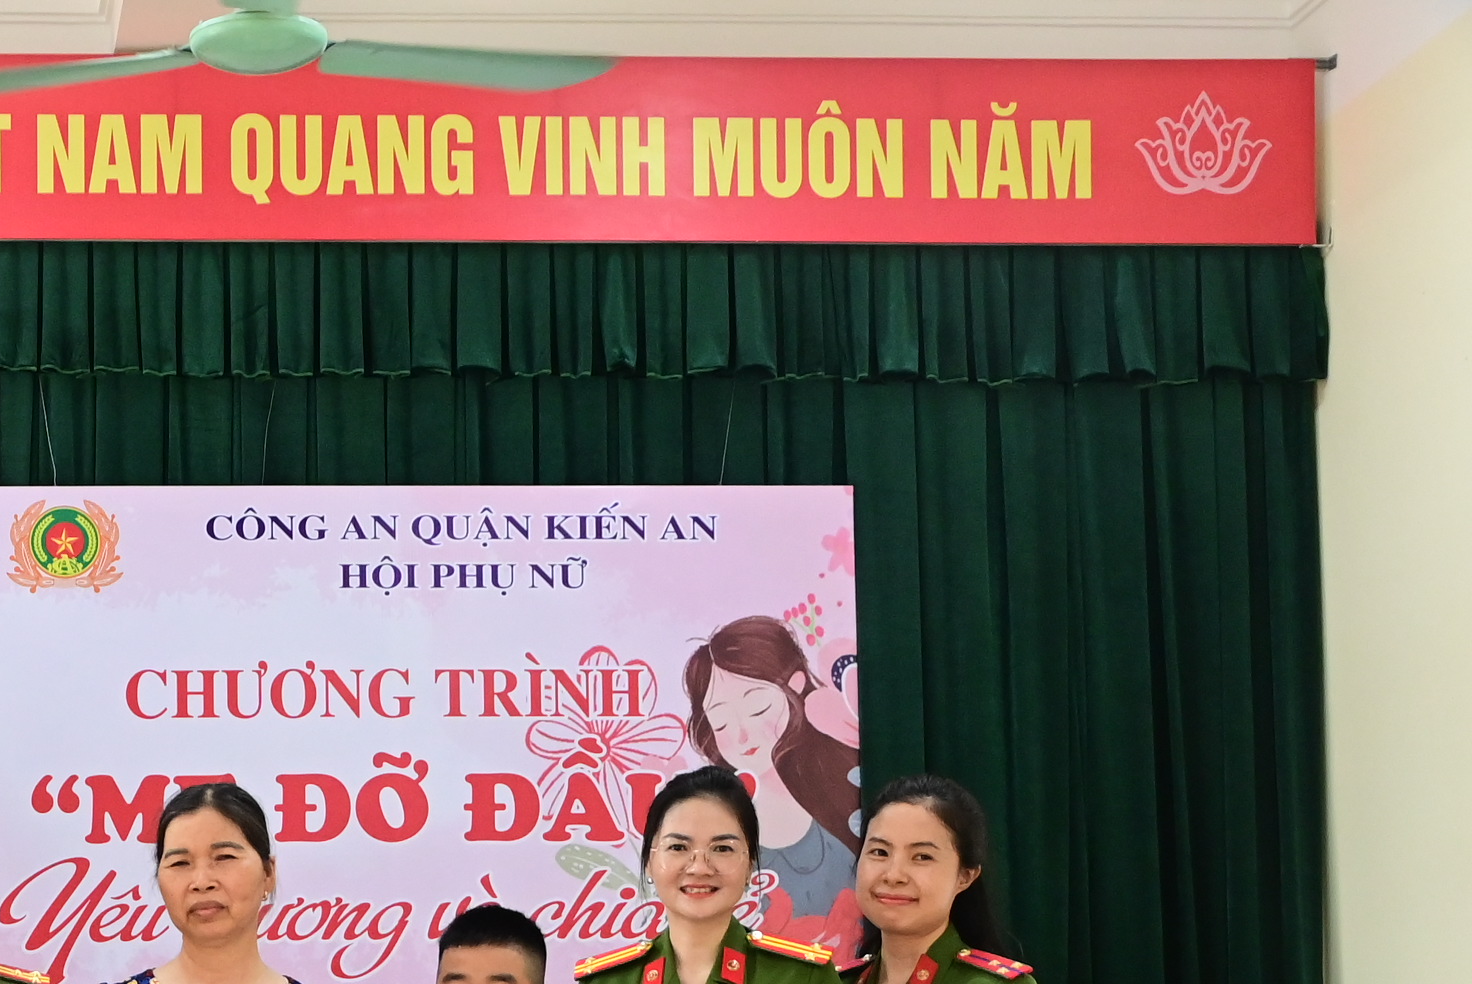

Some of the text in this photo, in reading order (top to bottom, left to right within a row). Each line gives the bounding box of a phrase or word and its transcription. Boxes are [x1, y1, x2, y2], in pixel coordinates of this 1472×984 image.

[36, 113, 203, 195] NAM
[230, 112, 474, 205] QUANG
[498, 115, 665, 196] VINH
[692, 99, 904, 199] MUÔN
[929, 102, 1093, 199] NĂM
[205, 502, 717, 547] CÔNG AN QUẬN KIẾN AN
[338, 556, 588, 596] HỘI PHỤ NỮ
[125, 652, 645, 719] CHƯƠNG TRÌNH
[31, 773, 236, 844] “M
[274, 752, 429, 843] ĐỠ
[257, 896, 413, 980] ương
[530, 869, 668, 940] chia
